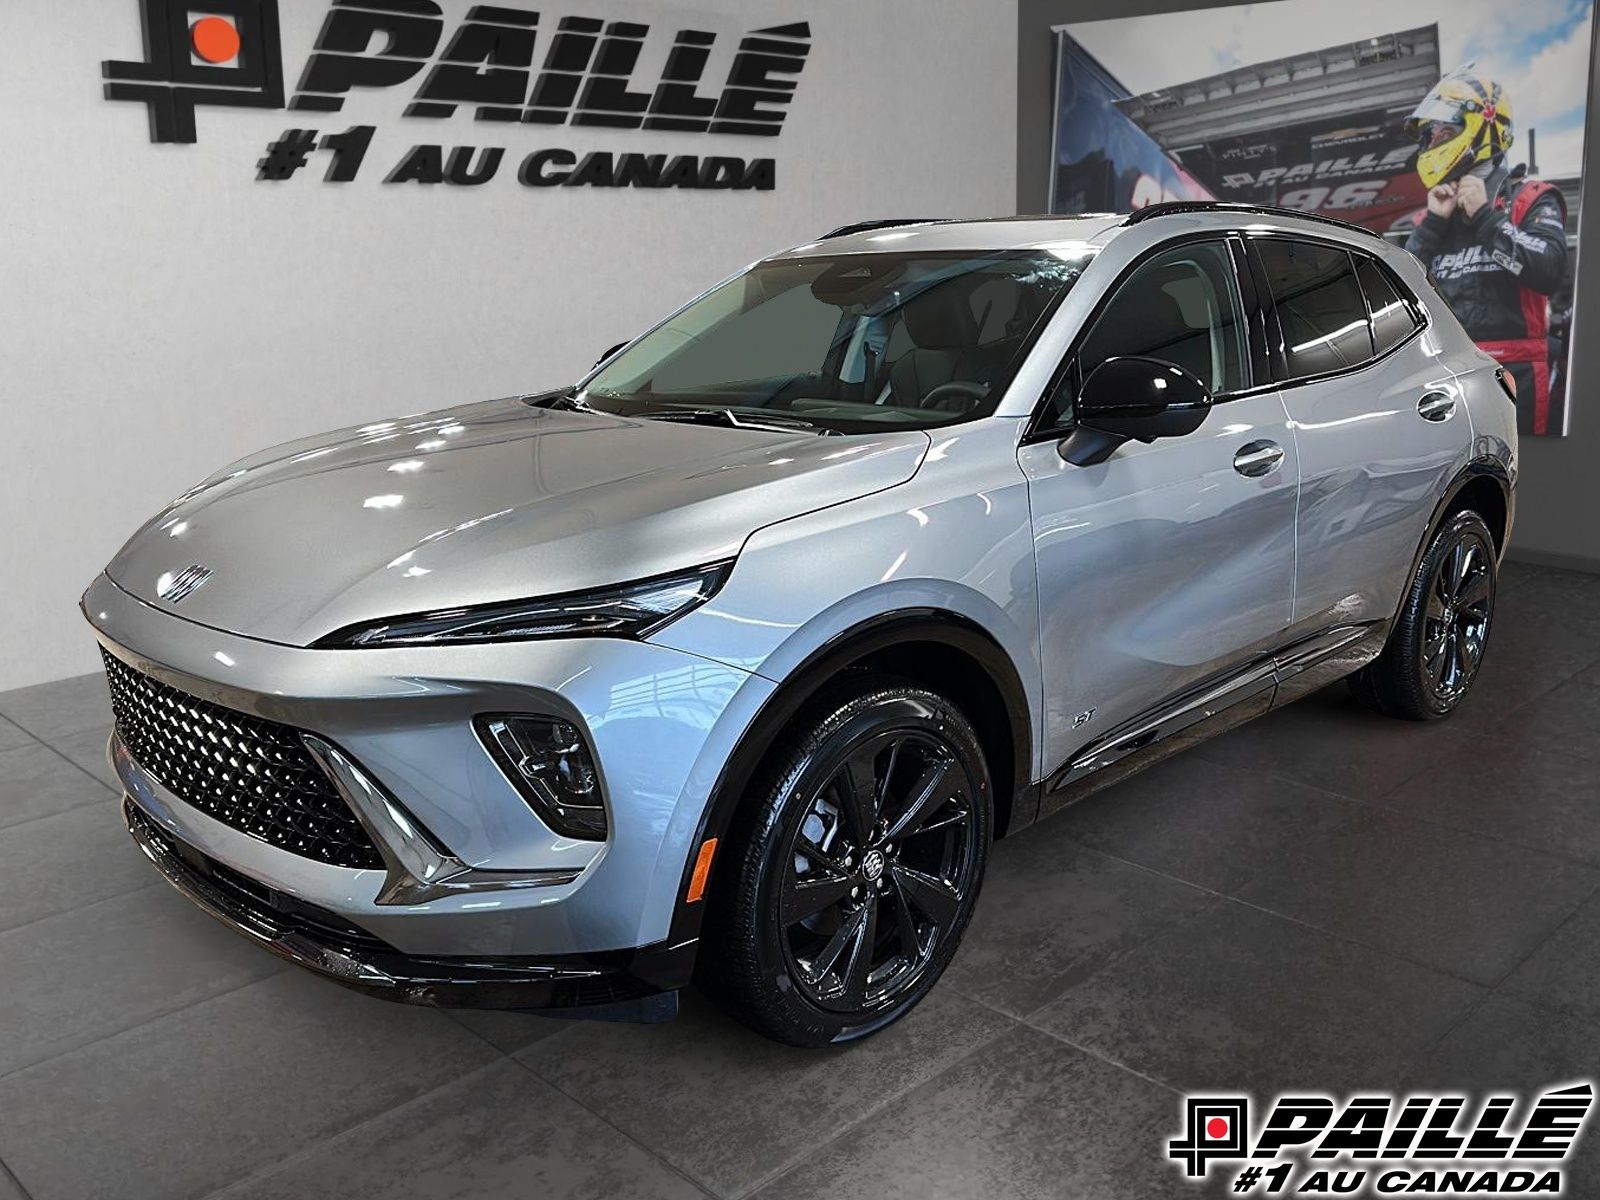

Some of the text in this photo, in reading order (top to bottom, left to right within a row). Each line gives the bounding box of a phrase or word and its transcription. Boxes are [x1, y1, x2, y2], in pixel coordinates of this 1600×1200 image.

[287, 0, 811, 136] PAILLÉ
[255, 126, 775, 191] #1 AU CANADA
[1280, 180, 1387, 210] 96
